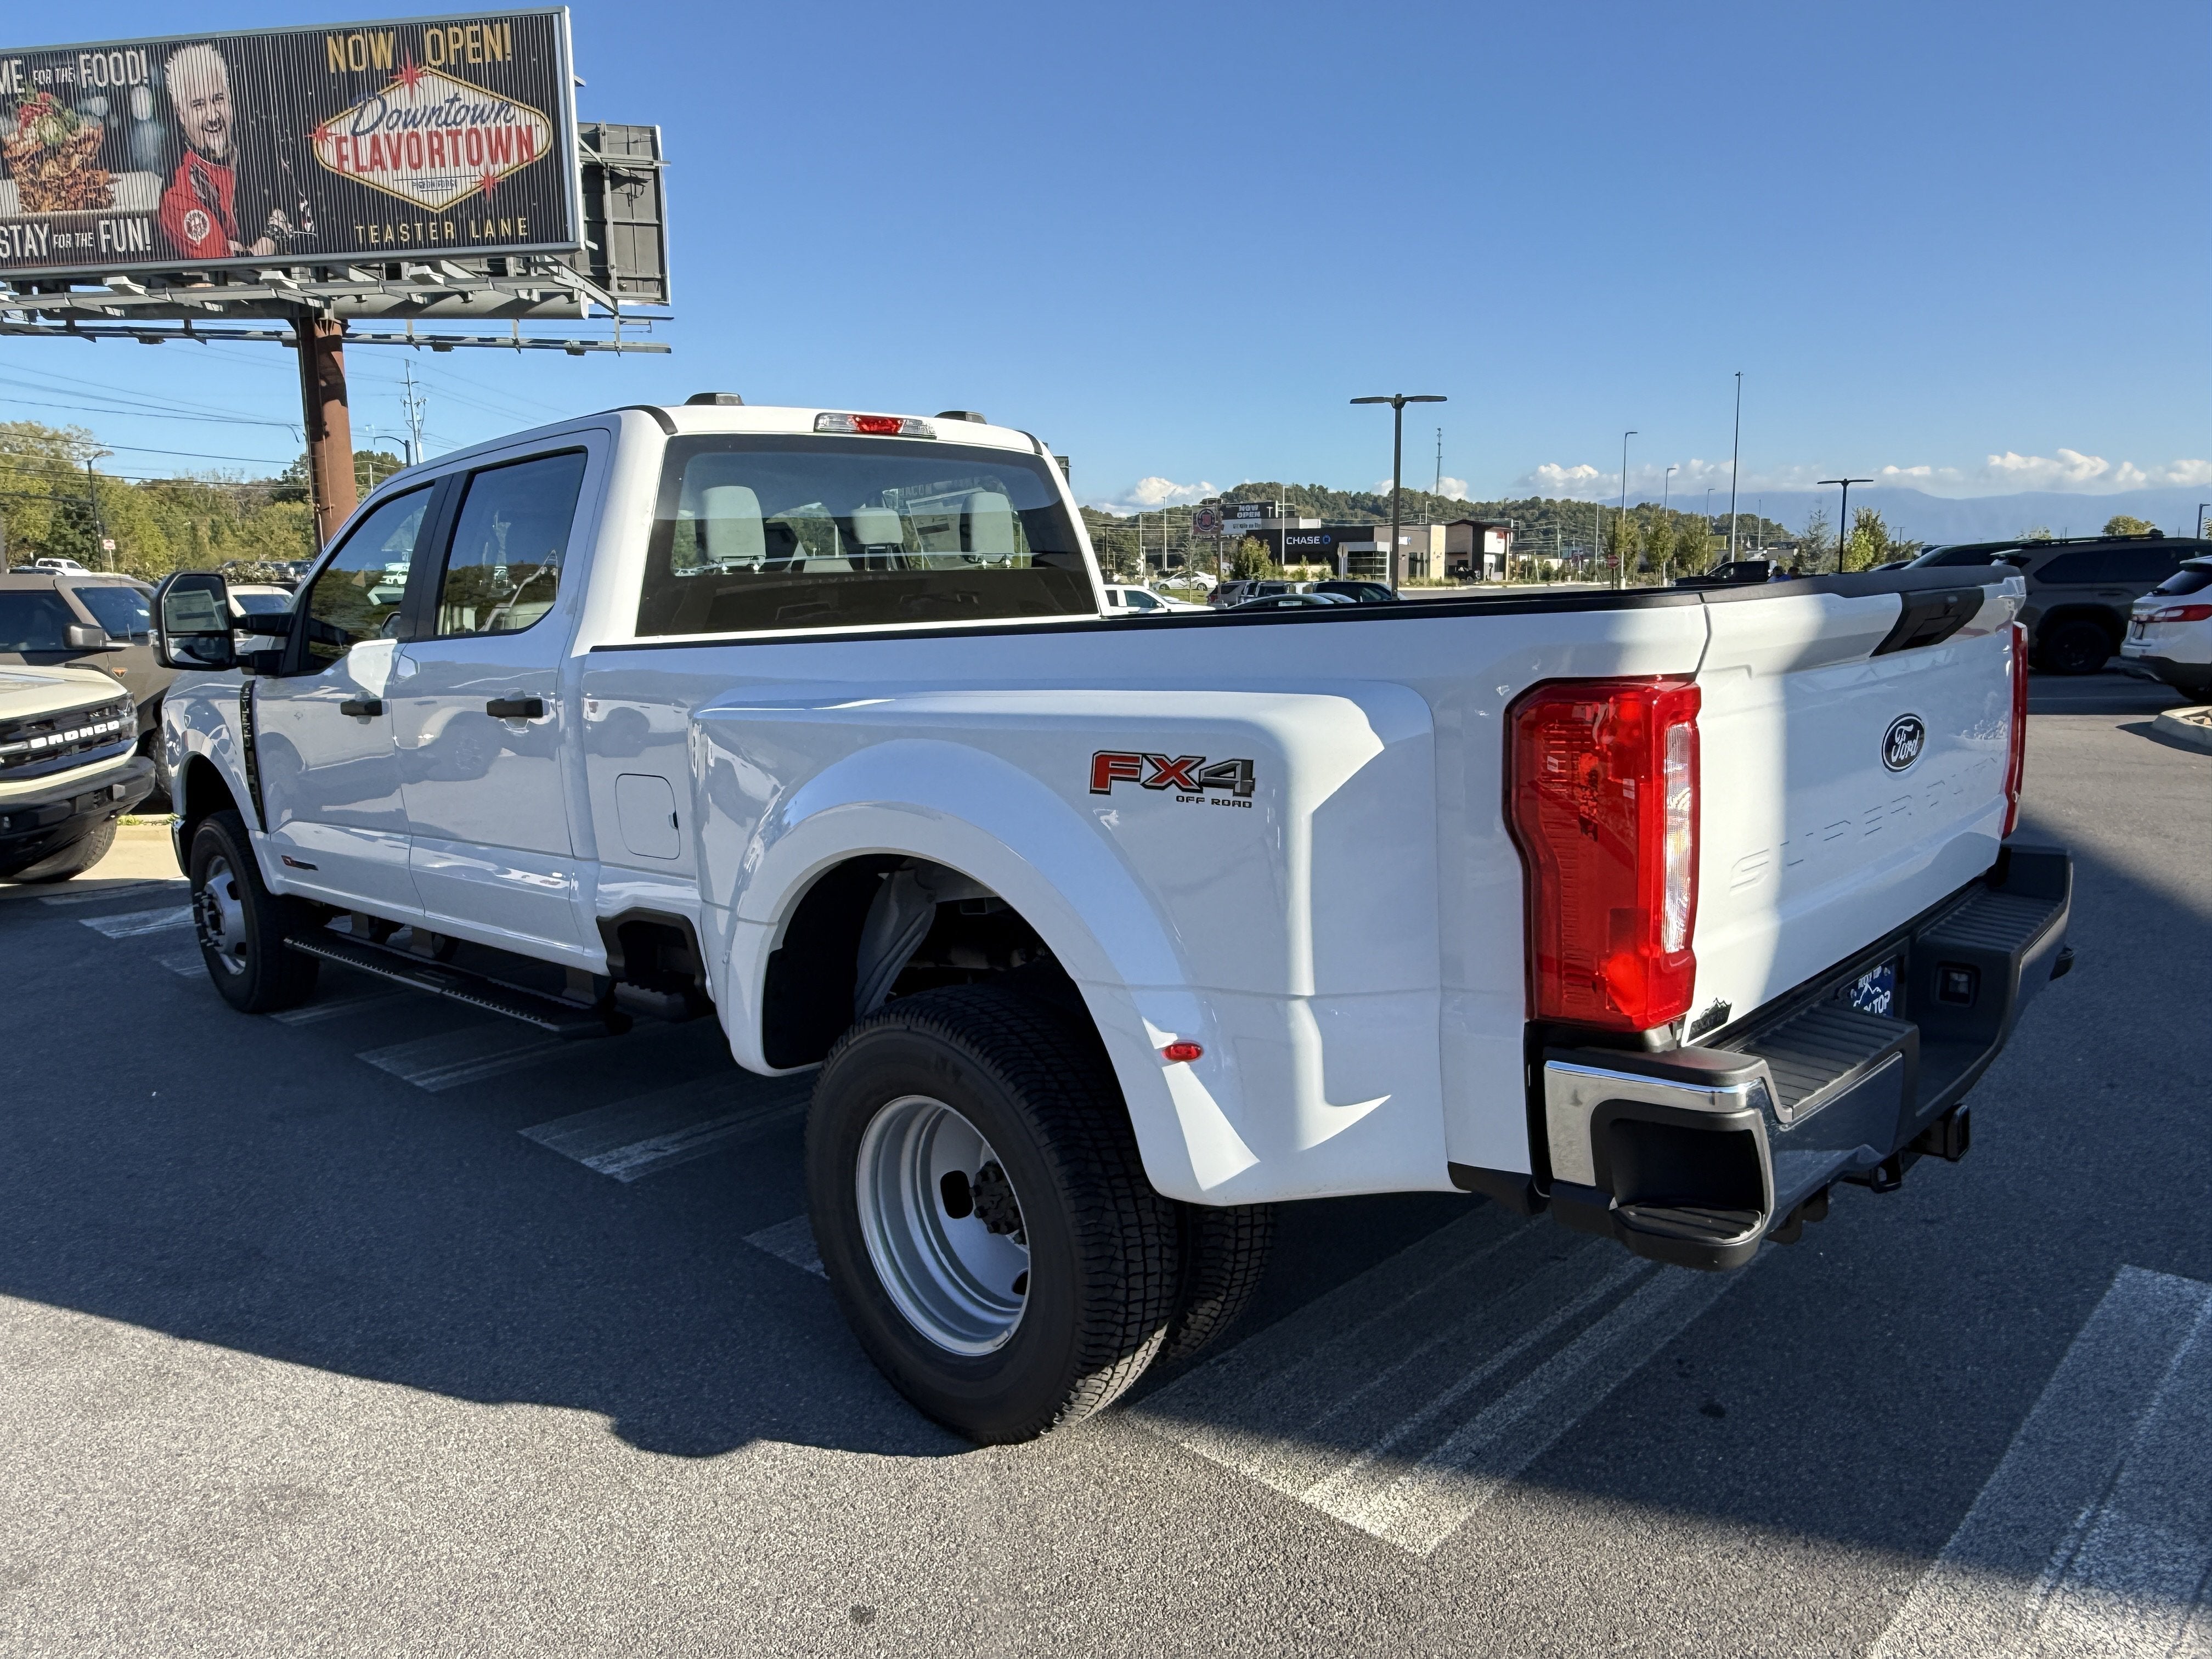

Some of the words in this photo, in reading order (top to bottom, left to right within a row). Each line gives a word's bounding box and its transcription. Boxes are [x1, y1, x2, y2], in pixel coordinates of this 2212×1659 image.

[326, 31, 394, 73] NOW
[426, 22, 512, 66] OPEN!
[33, 69, 52, 84] FOR
[55, 67, 75, 82] THE
[79, 49, 148, 88] FOOD!
[351, 91, 515, 136] Downtown
[335, 125, 534, 173] FLAVORTOWN
[0, 223, 49, 258] STAY
[53, 233, 71, 248] FOR
[75, 232, 93, 247] THE
[99, 217, 151, 253] FUN!
[356, 221, 454, 244] TEASTER
[470, 217, 528, 238] LANE
[1286, 536, 1320, 544] CHASE
[31, 720, 119, 748] BRONCO
[1892, 724, 1920, 762] Ford
[1090, 750, 1255, 797] FX4
[1176, 795, 1205, 804] OFF
[1211, 798, 1252, 808] ROAD
[1873, 991, 1890, 1013] TOP
